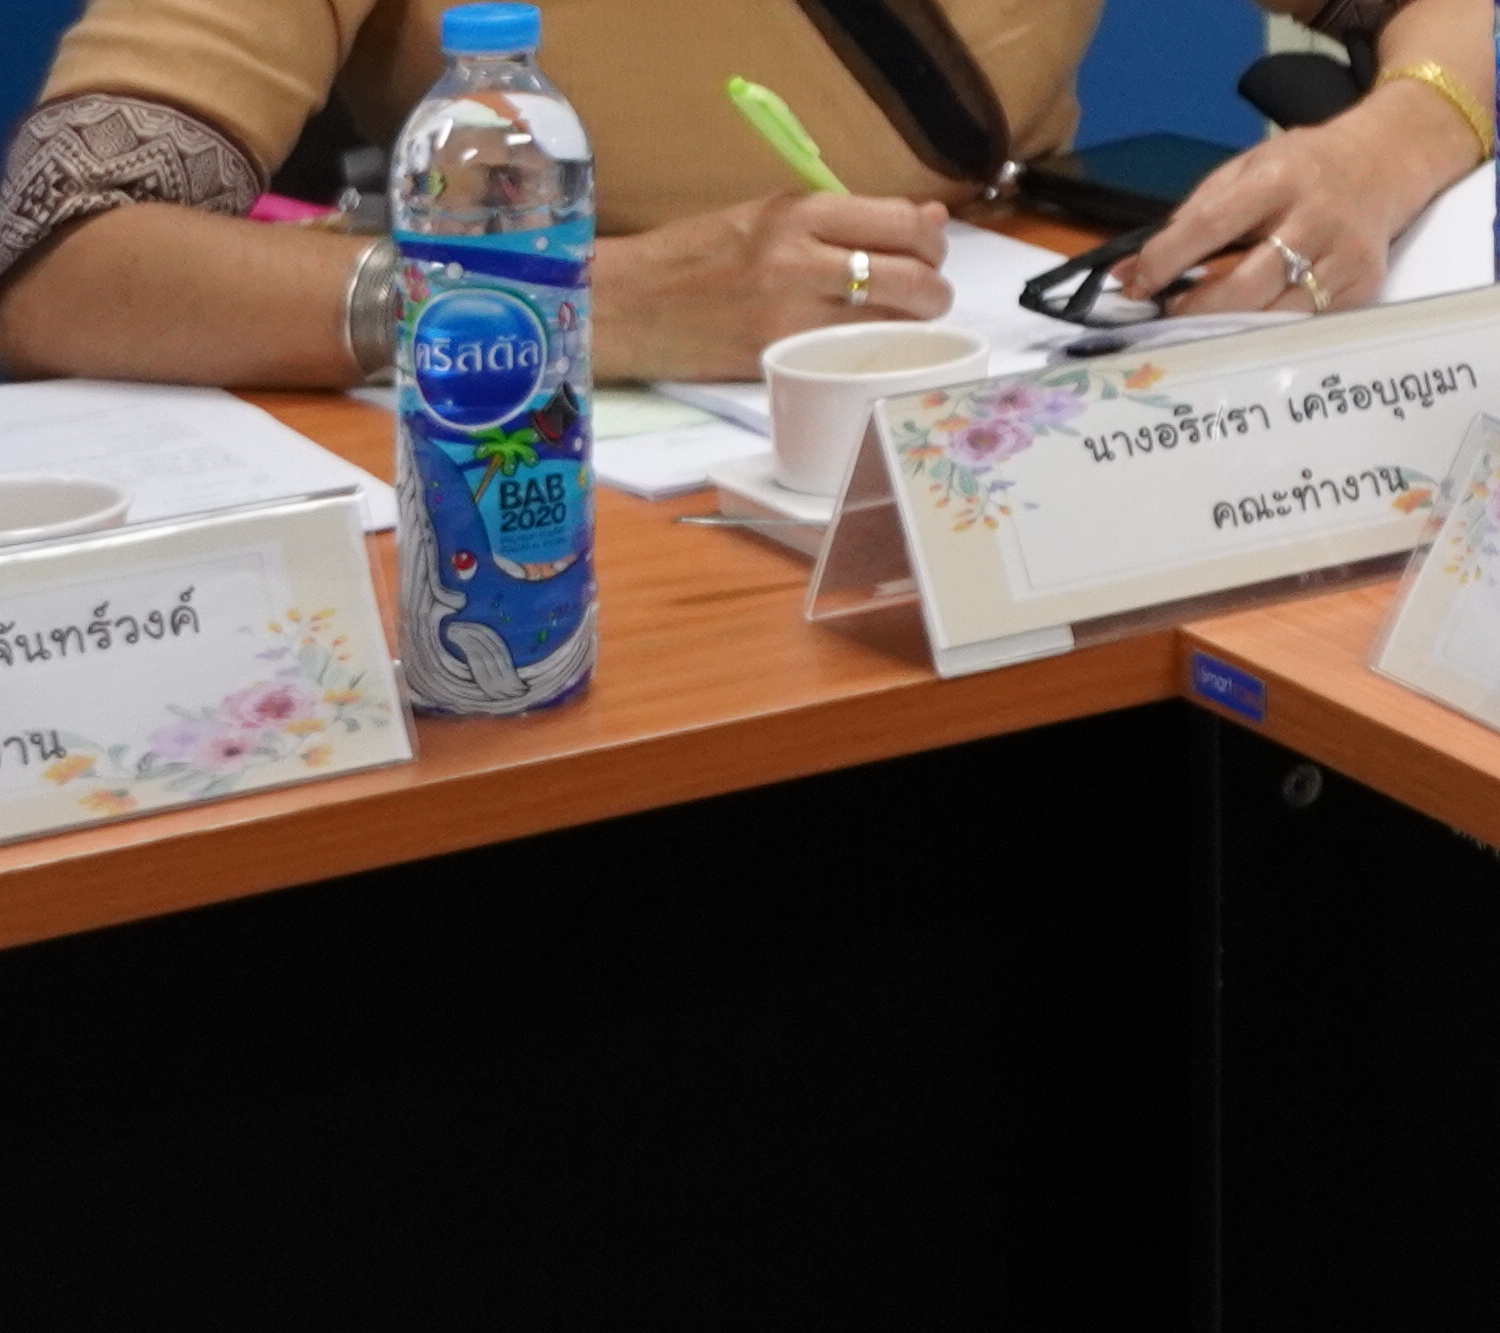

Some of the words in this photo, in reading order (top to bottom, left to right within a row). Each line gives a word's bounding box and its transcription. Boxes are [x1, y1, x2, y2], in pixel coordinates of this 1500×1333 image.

[1288, 362, 1478, 421] เครือบุญมา
[499, 473, 566, 510] BAB
[1213, 466, 1408, 530] คณะทำงาน
[500, 501, 567, 533] 2020
[0, 729, 67, 767] าน
